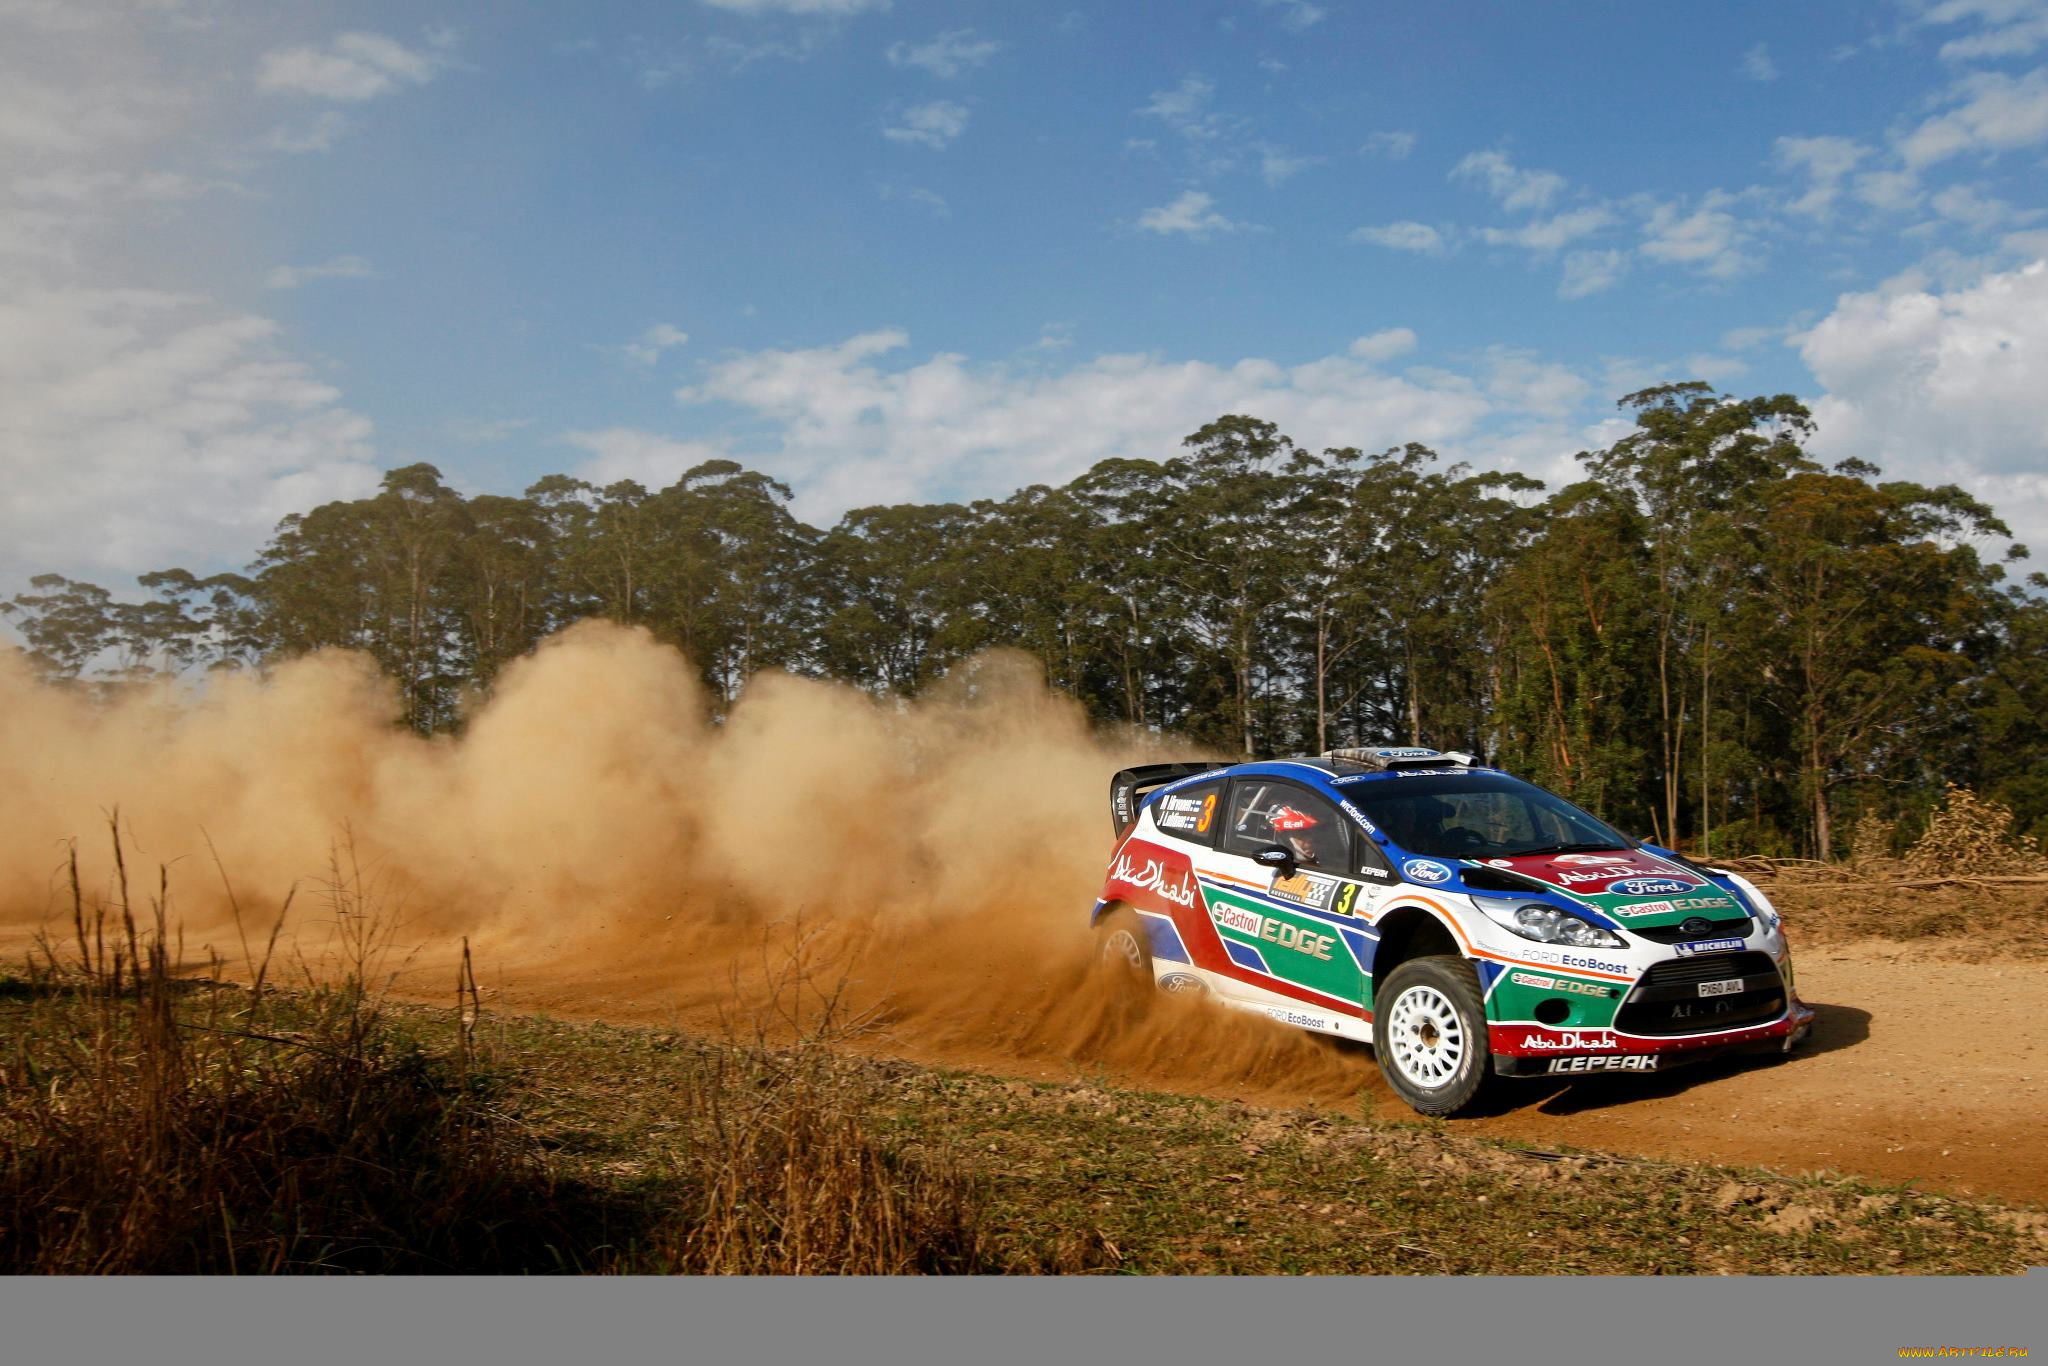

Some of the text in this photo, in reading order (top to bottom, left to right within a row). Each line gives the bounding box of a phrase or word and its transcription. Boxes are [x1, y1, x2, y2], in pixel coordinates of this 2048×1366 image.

[1197, 793, 1217, 832] 3
[1340, 799, 1376, 834] wrcford.com
[1411, 861, 1444, 880] Ford
[1624, 880, 1684, 894] Ford
[1337, 883, 1356, 913] 3
[1630, 897, 1734, 915] Castrol EDGE
[1223, 907, 1336, 961] Castrol EDGE
[1694, 940, 1743, 951] MICHELIN
[1522, 950, 1559, 963] FORD
[1562, 955, 1628, 974] EcoBoost
[1520, 976, 1611, 998] Castrol EDGE
[1701, 980, 1742, 996] PX60 AVL
[1267, 1008, 1325, 1028] FORD EcoBoost
[1548, 1055, 1659, 1073] ICEPEAK
